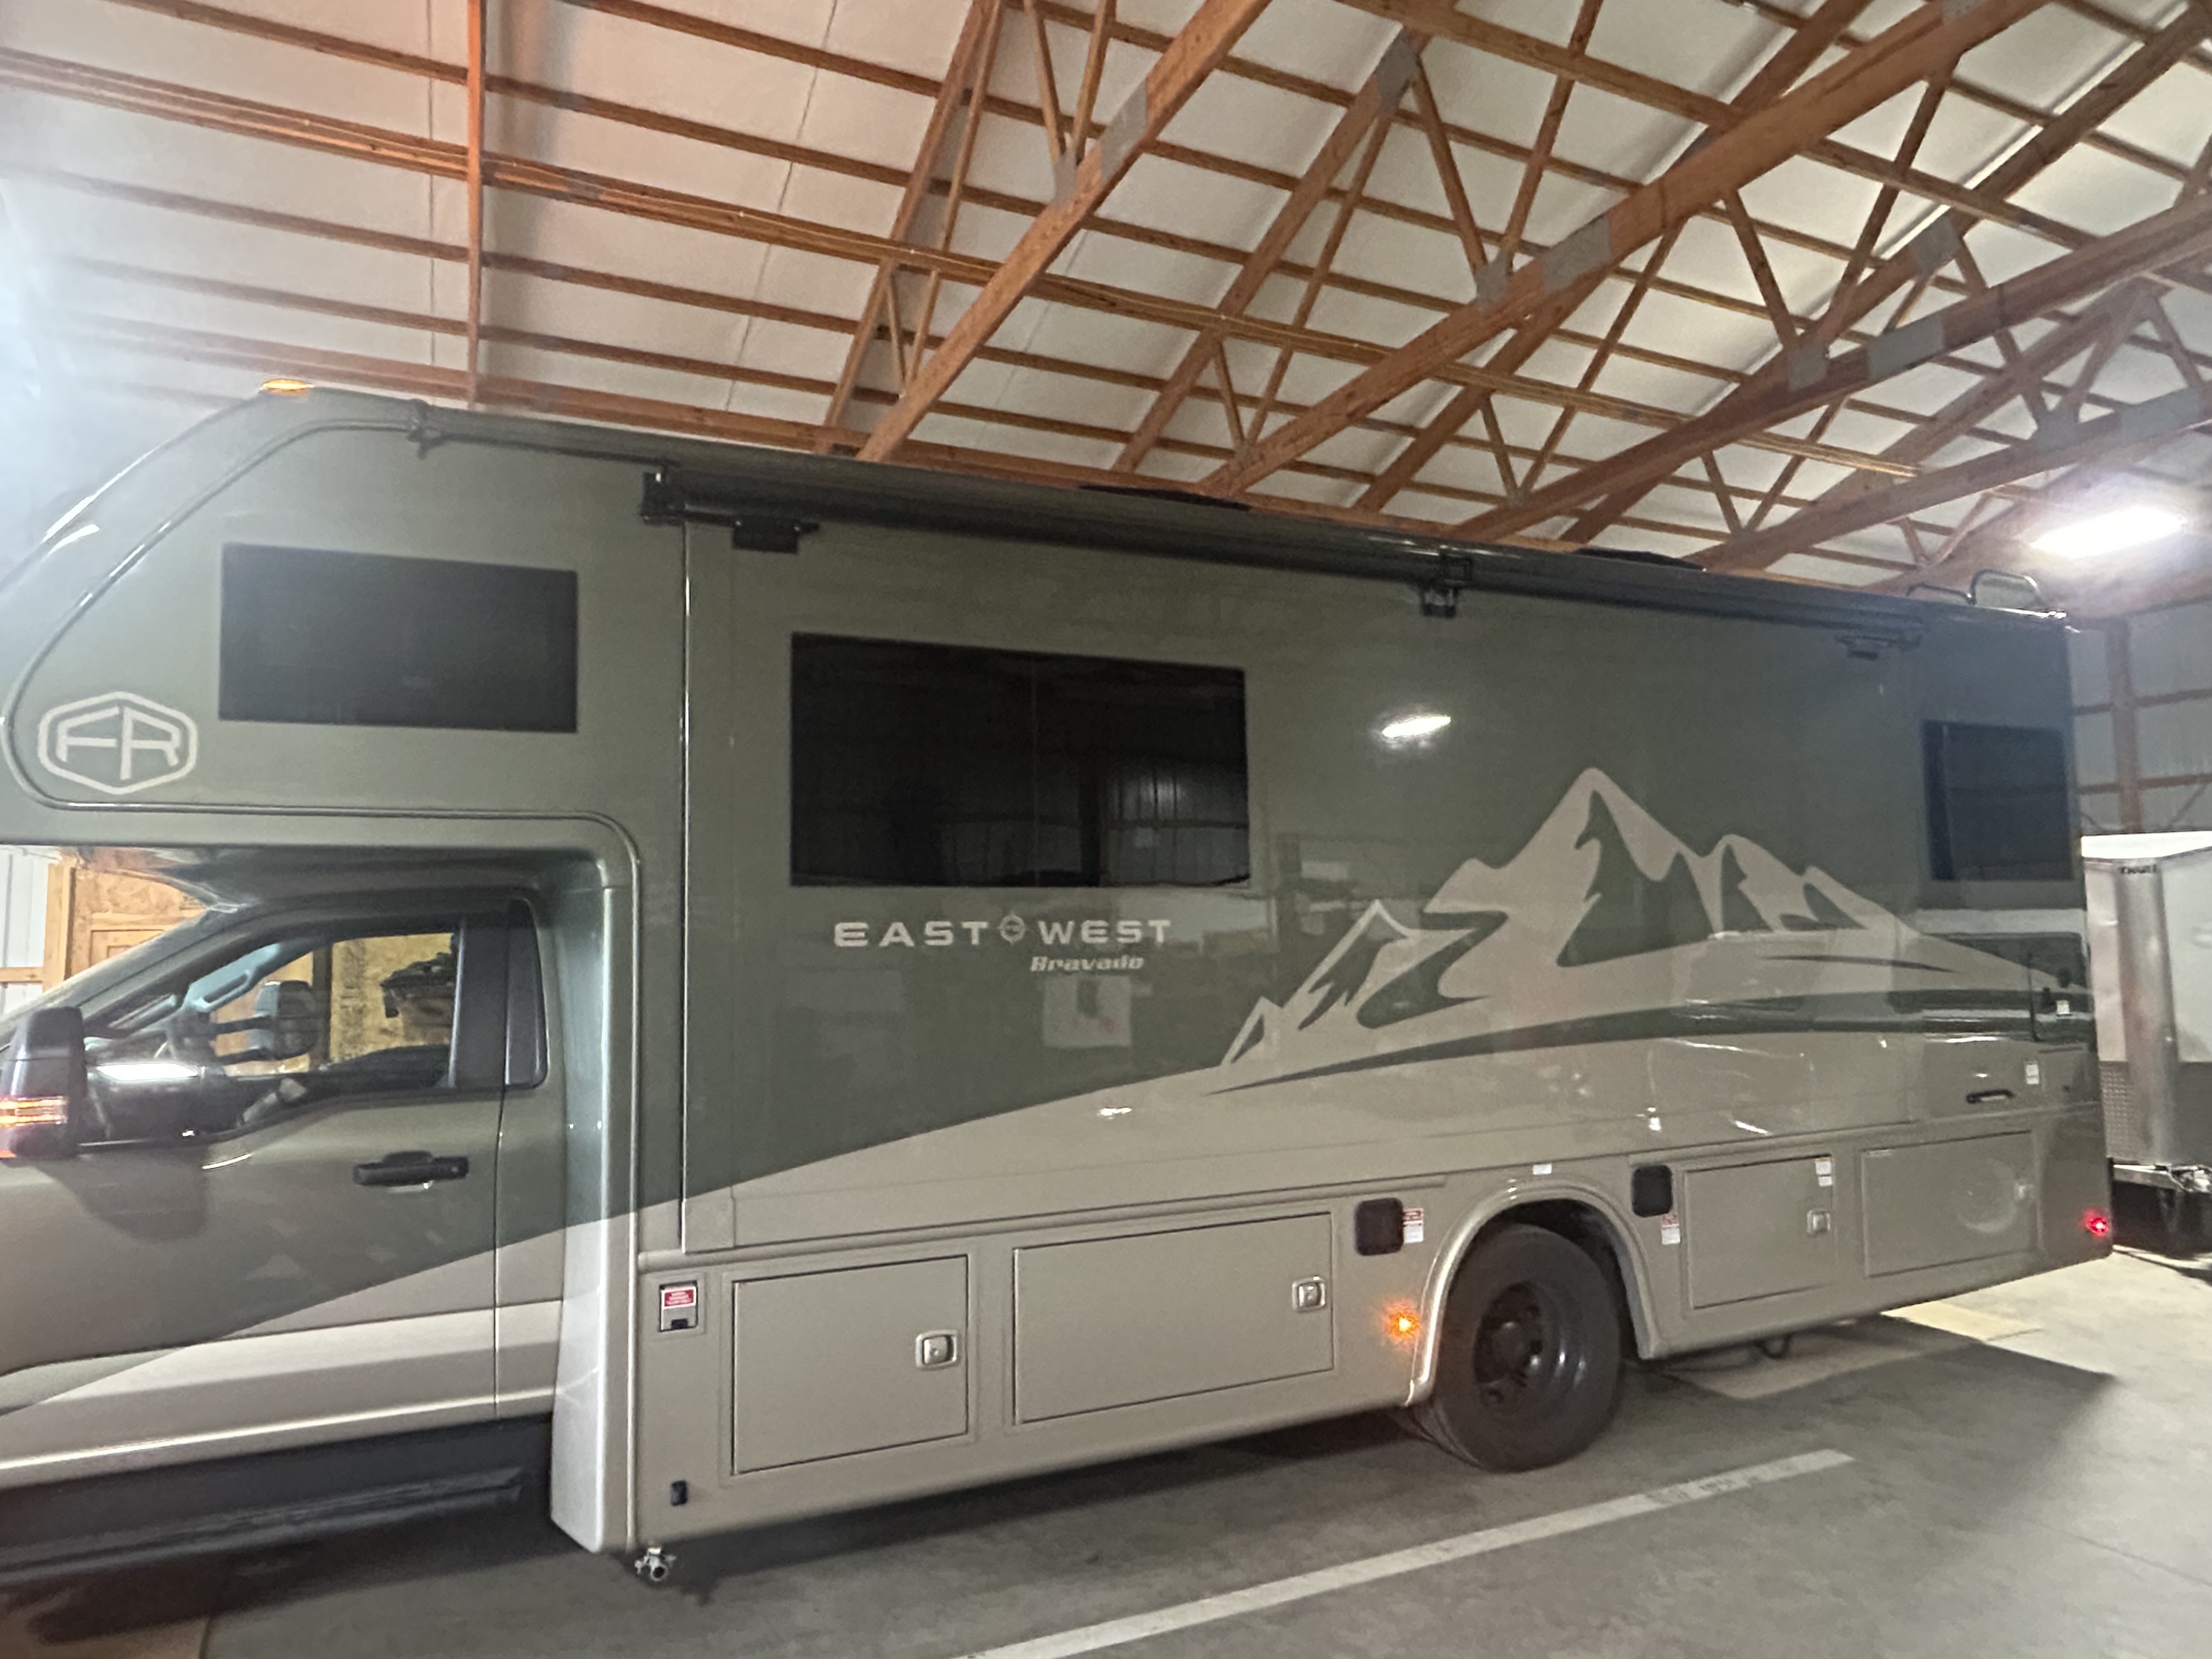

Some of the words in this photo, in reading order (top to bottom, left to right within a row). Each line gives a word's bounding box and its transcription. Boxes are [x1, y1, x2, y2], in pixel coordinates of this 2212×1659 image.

[833, 921, 988, 947] EAST
[1037, 919, 1171, 945] WEST
[1030, 955, 1144, 972] Bravado
